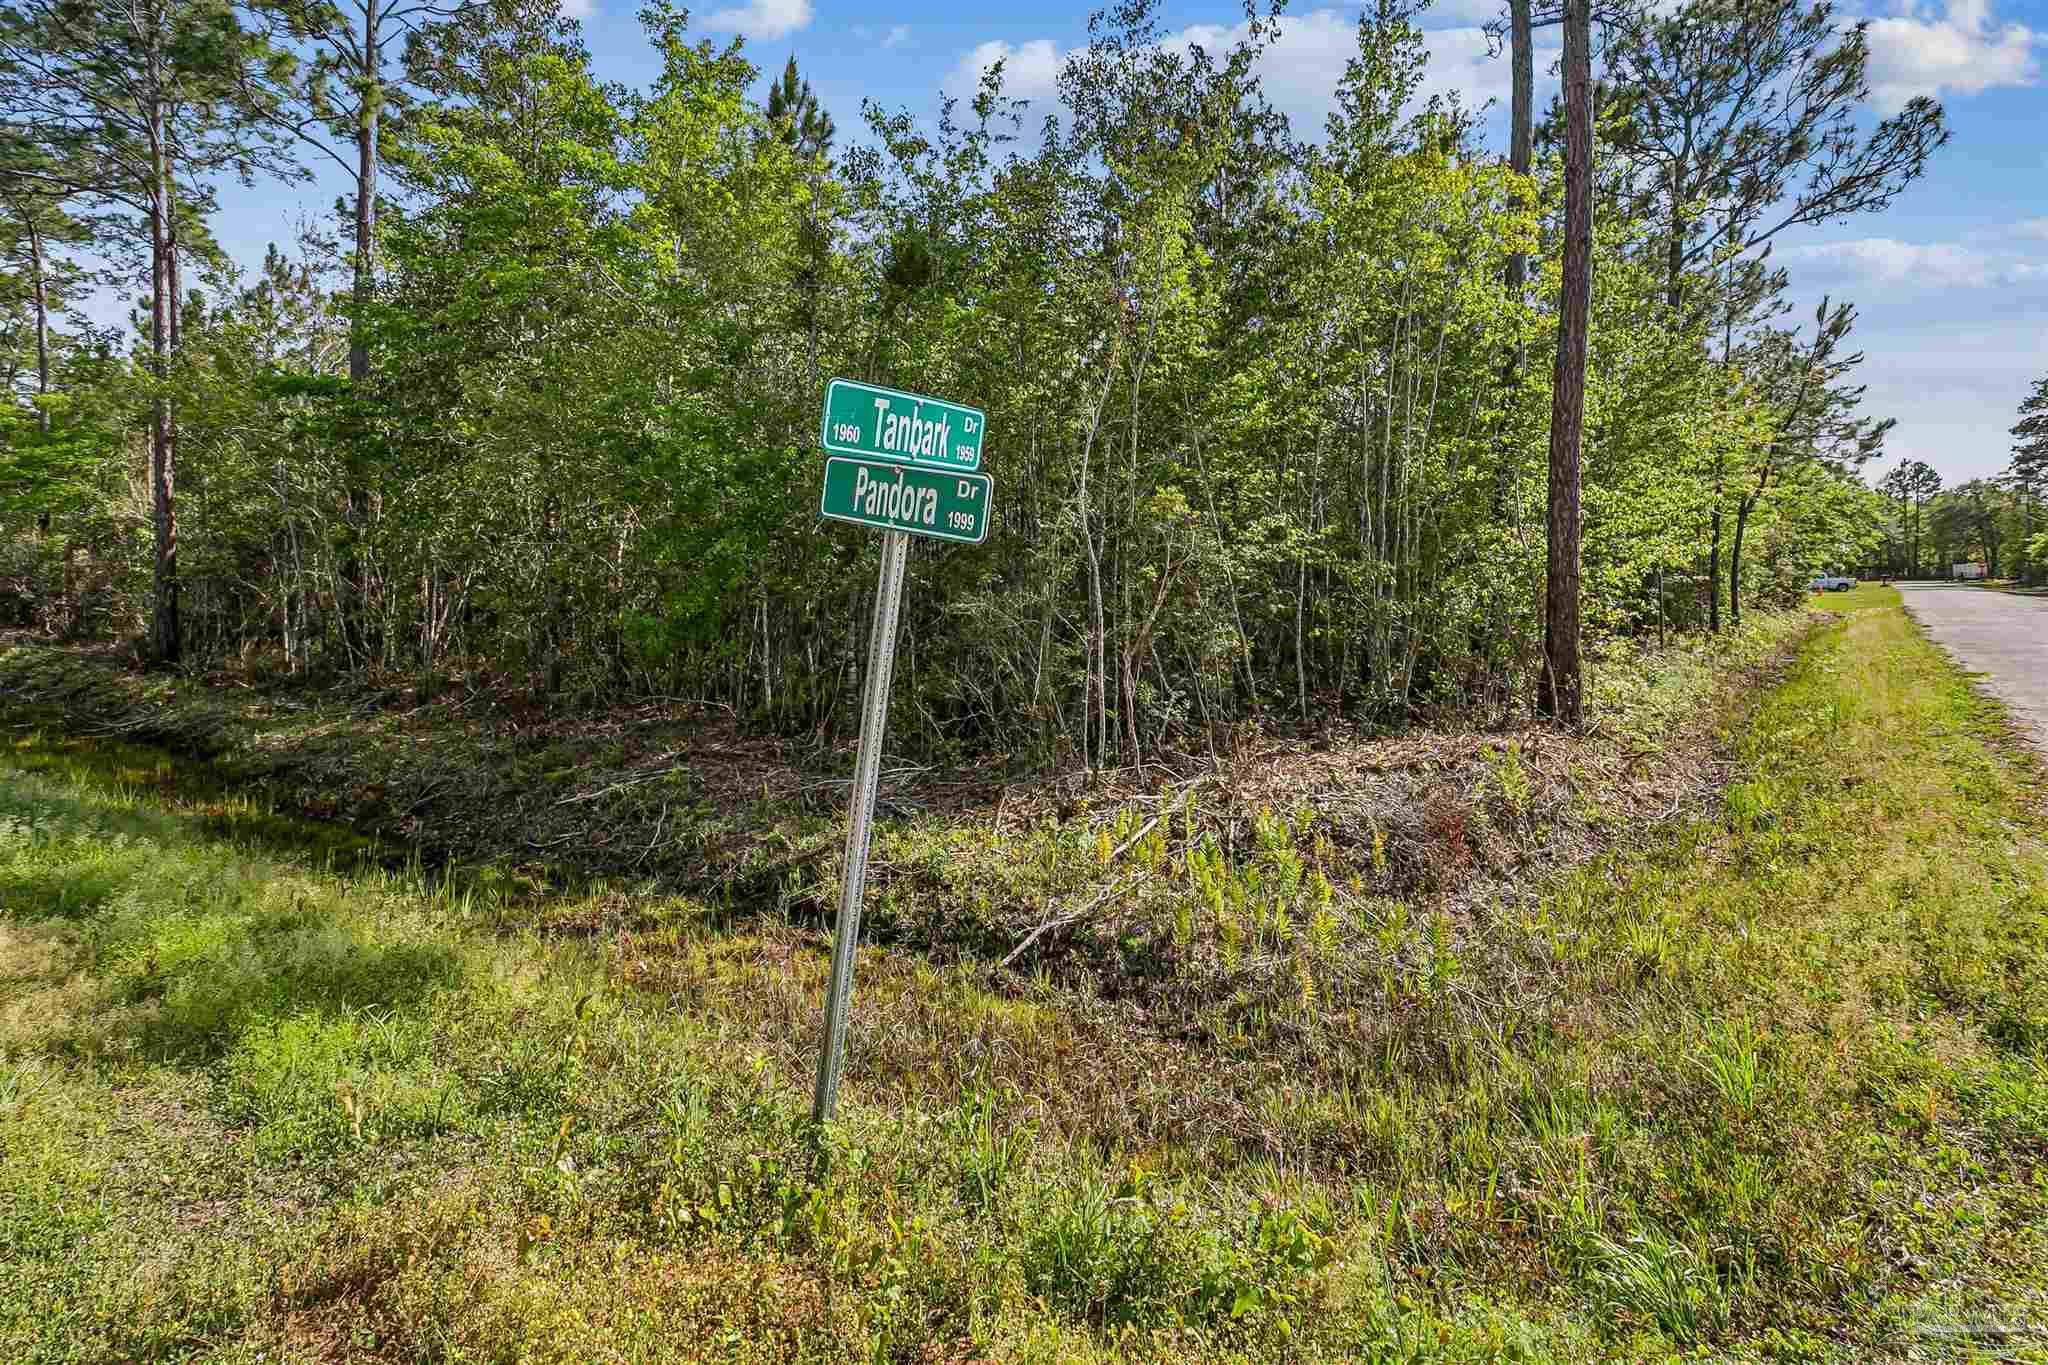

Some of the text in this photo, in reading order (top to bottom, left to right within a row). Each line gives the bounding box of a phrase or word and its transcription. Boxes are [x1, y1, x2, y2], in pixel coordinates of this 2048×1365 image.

[832, 422, 861, 444] 1960
[874, 398, 979, 458] Tanbark Dr
[956, 445, 975, 462] 1959
[853, 466, 979, 525] Pandora Dr
[948, 511, 975, 530] 1999
